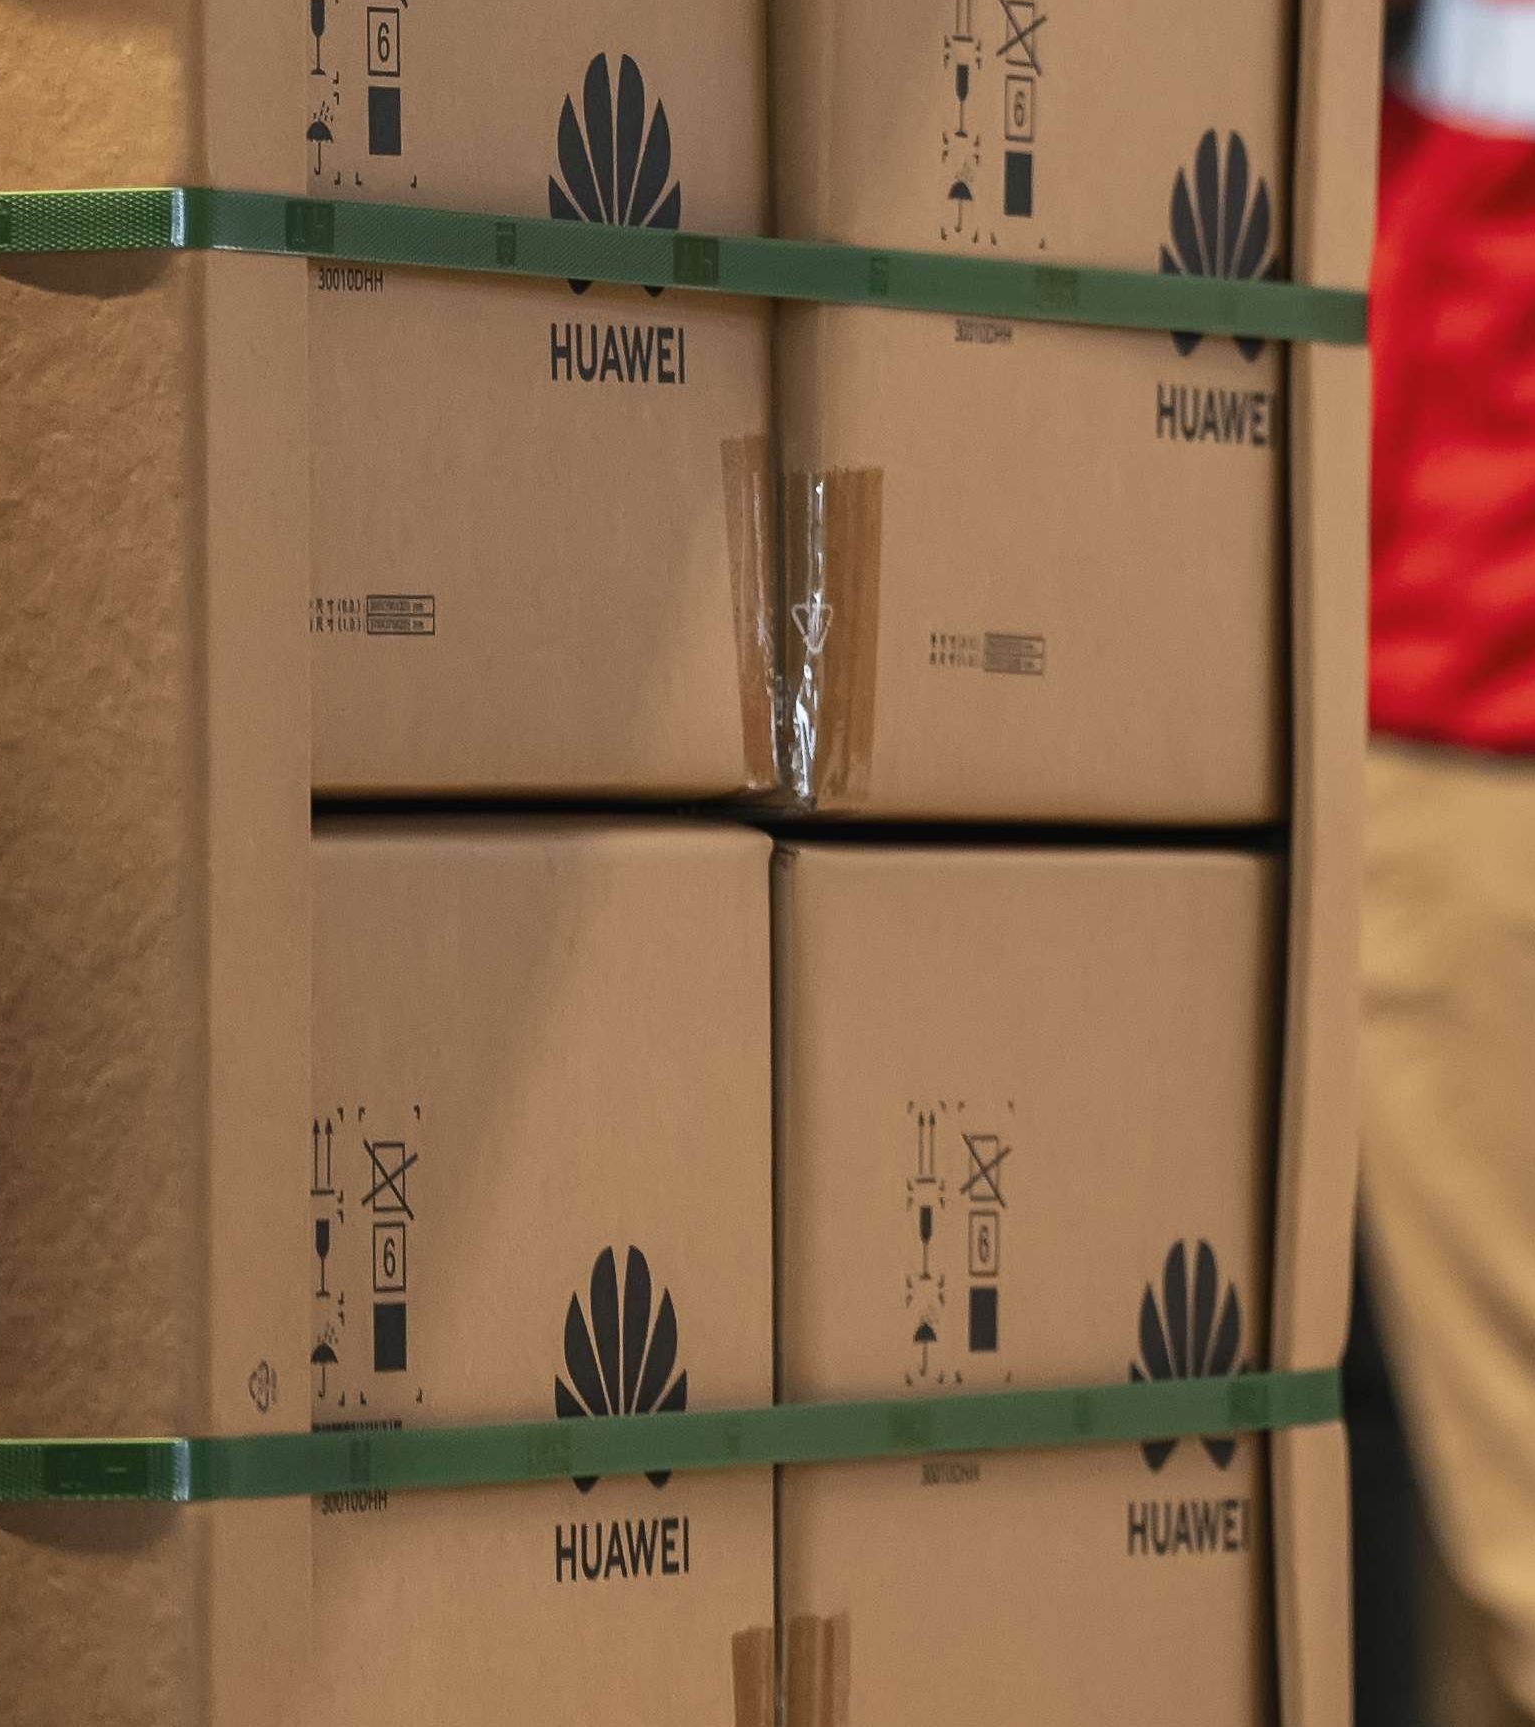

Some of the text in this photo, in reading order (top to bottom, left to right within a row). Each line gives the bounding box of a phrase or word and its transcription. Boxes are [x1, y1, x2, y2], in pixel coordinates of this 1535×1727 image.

[376, 24, 391, 63] 6
[1013, 90, 1027, 128] 6
[318, 268, 384, 293] 30010DHH
[550, 322, 685, 384] HUAWEI
[383, 1238, 397, 1279] 6
[977, 1225, 990, 1263] 6
[1126, 1499, 1251, 1556] HUAWEI
[555, 1517, 690, 1582] HUAWEI
